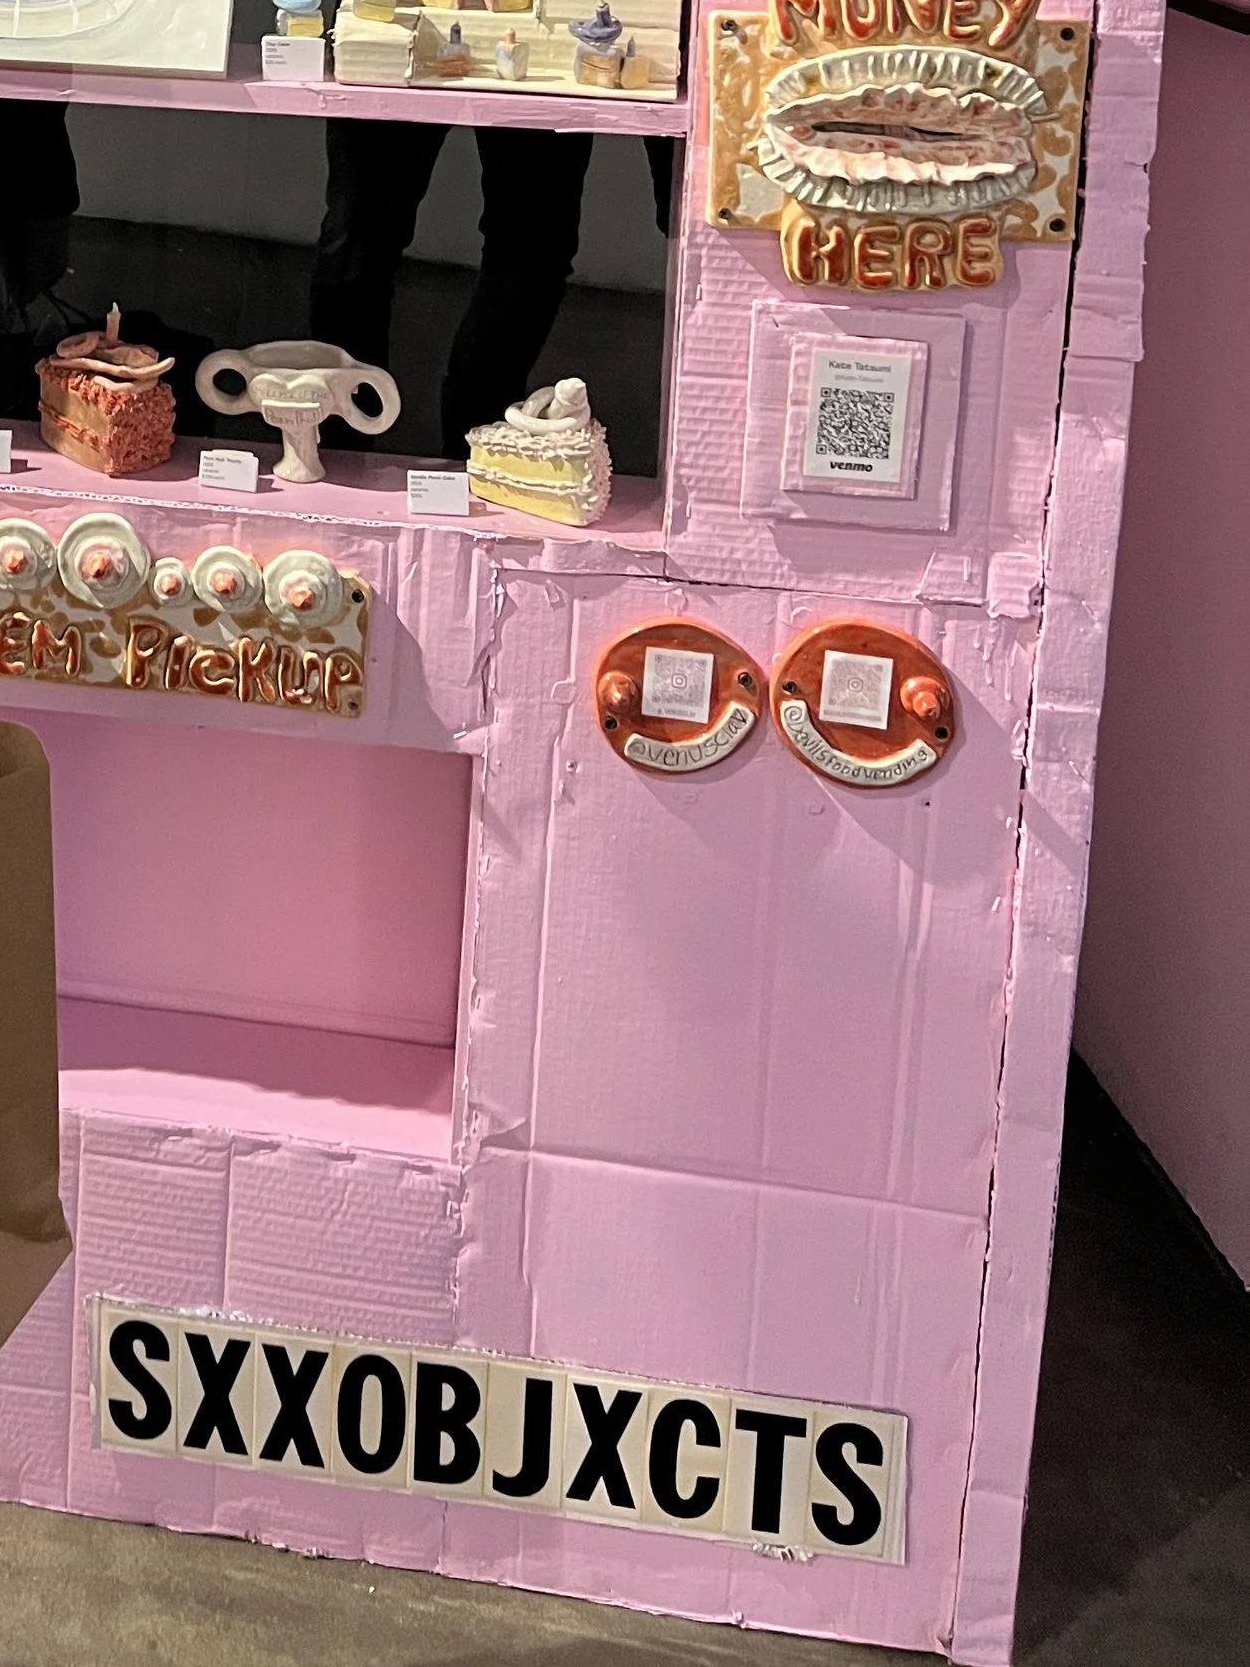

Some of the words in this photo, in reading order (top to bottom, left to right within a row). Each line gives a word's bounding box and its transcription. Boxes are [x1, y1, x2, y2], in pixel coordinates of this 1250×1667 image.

[792, 217, 999, 289] HERE
[829, 460, 873, 473] venmo
[125, 615, 364, 712] PICKUP
[108, 1319, 885, 1546] SXXOBJXCTS
